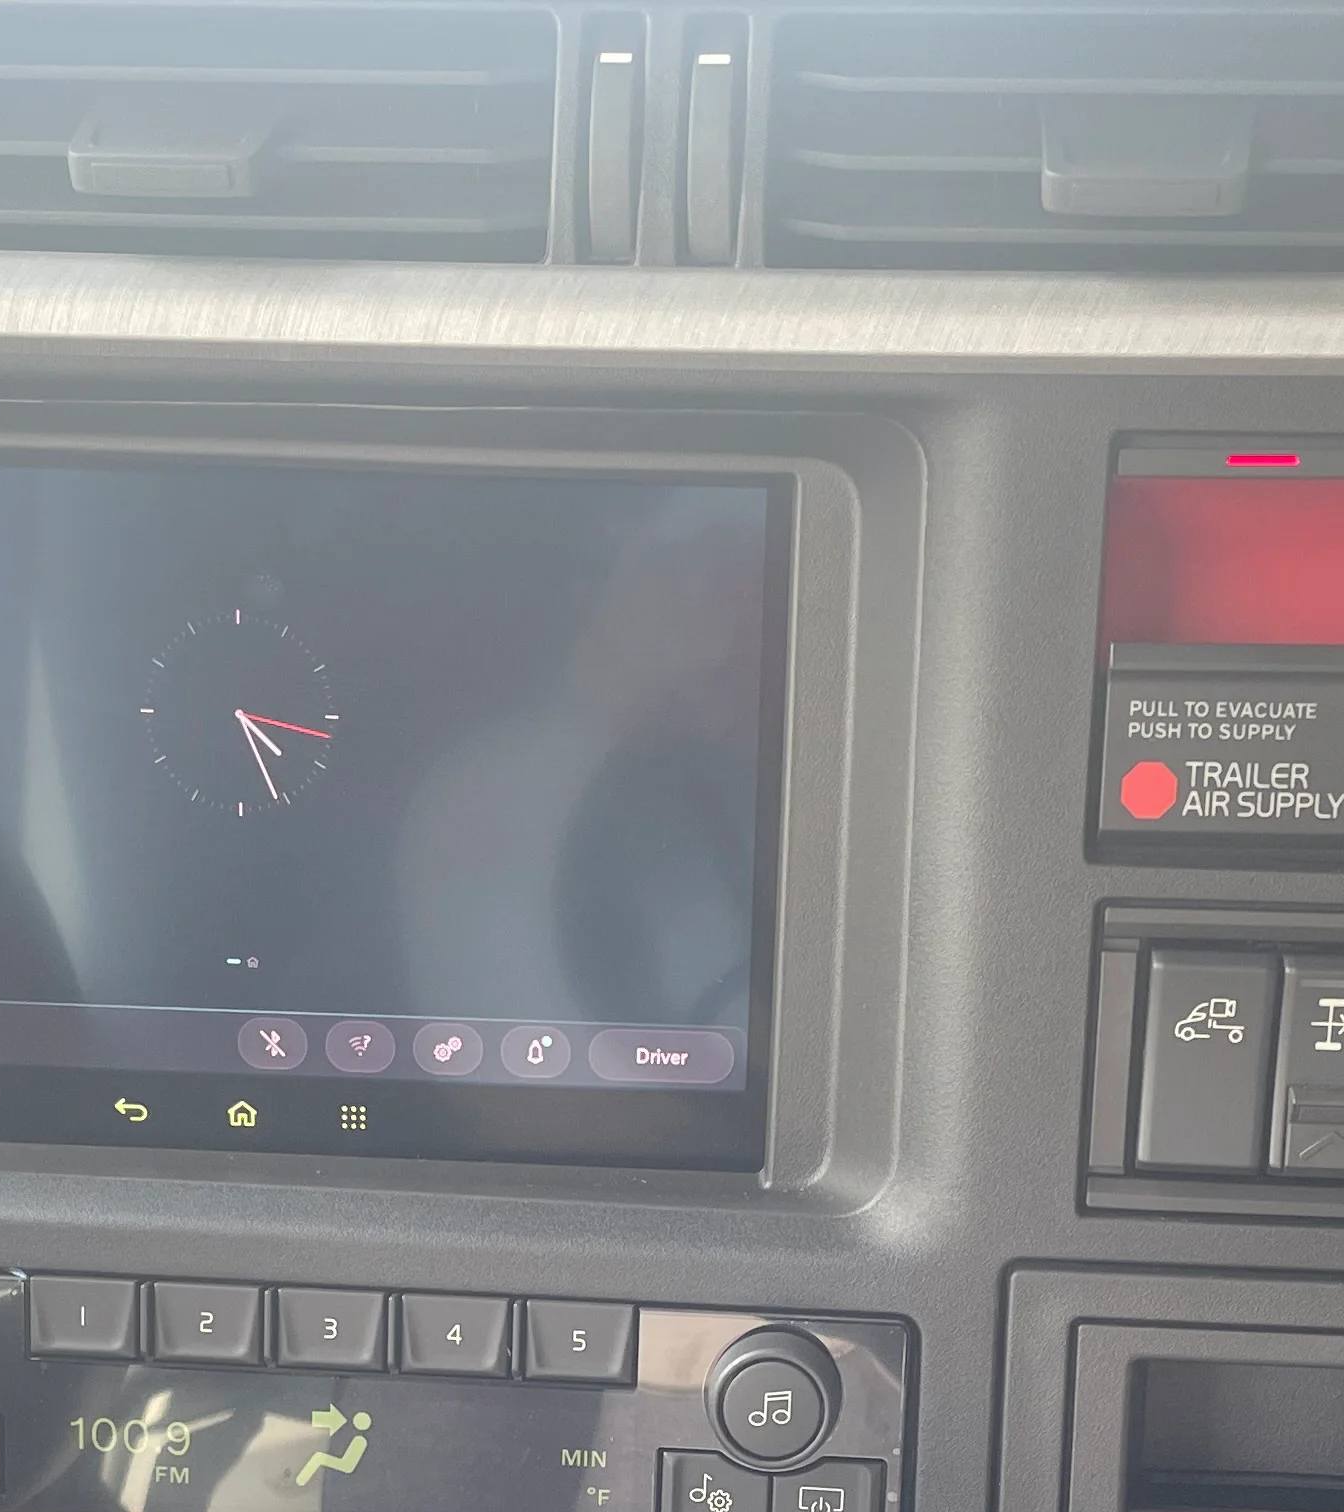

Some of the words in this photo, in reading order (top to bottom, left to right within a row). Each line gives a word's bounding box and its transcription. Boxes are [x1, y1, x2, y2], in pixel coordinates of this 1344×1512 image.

[1129, 700, 1179, 717] PULL
[1184, 701, 1210, 718] TO
[1215, 701, 1318, 719] EVACUATE
[1128, 721, 1182, 739] PUSH
[1187, 722, 1213, 740] TO
[1218, 723, 1297, 741] SUPPLY
[1185, 761, 1310, 791] TRAILER
[1181, 790, 1231, 817] AIR
[636, 1047, 689, 1066] Driver
[199, 1311, 214, 1333] 2
[323, 1317, 338, 1339] 3
[446, 1324, 463, 1345] 4
[572, 1330, 587, 1352] 5
[561, 1448, 607, 1468] MIN
[154, 1464, 190, 1485] FM
